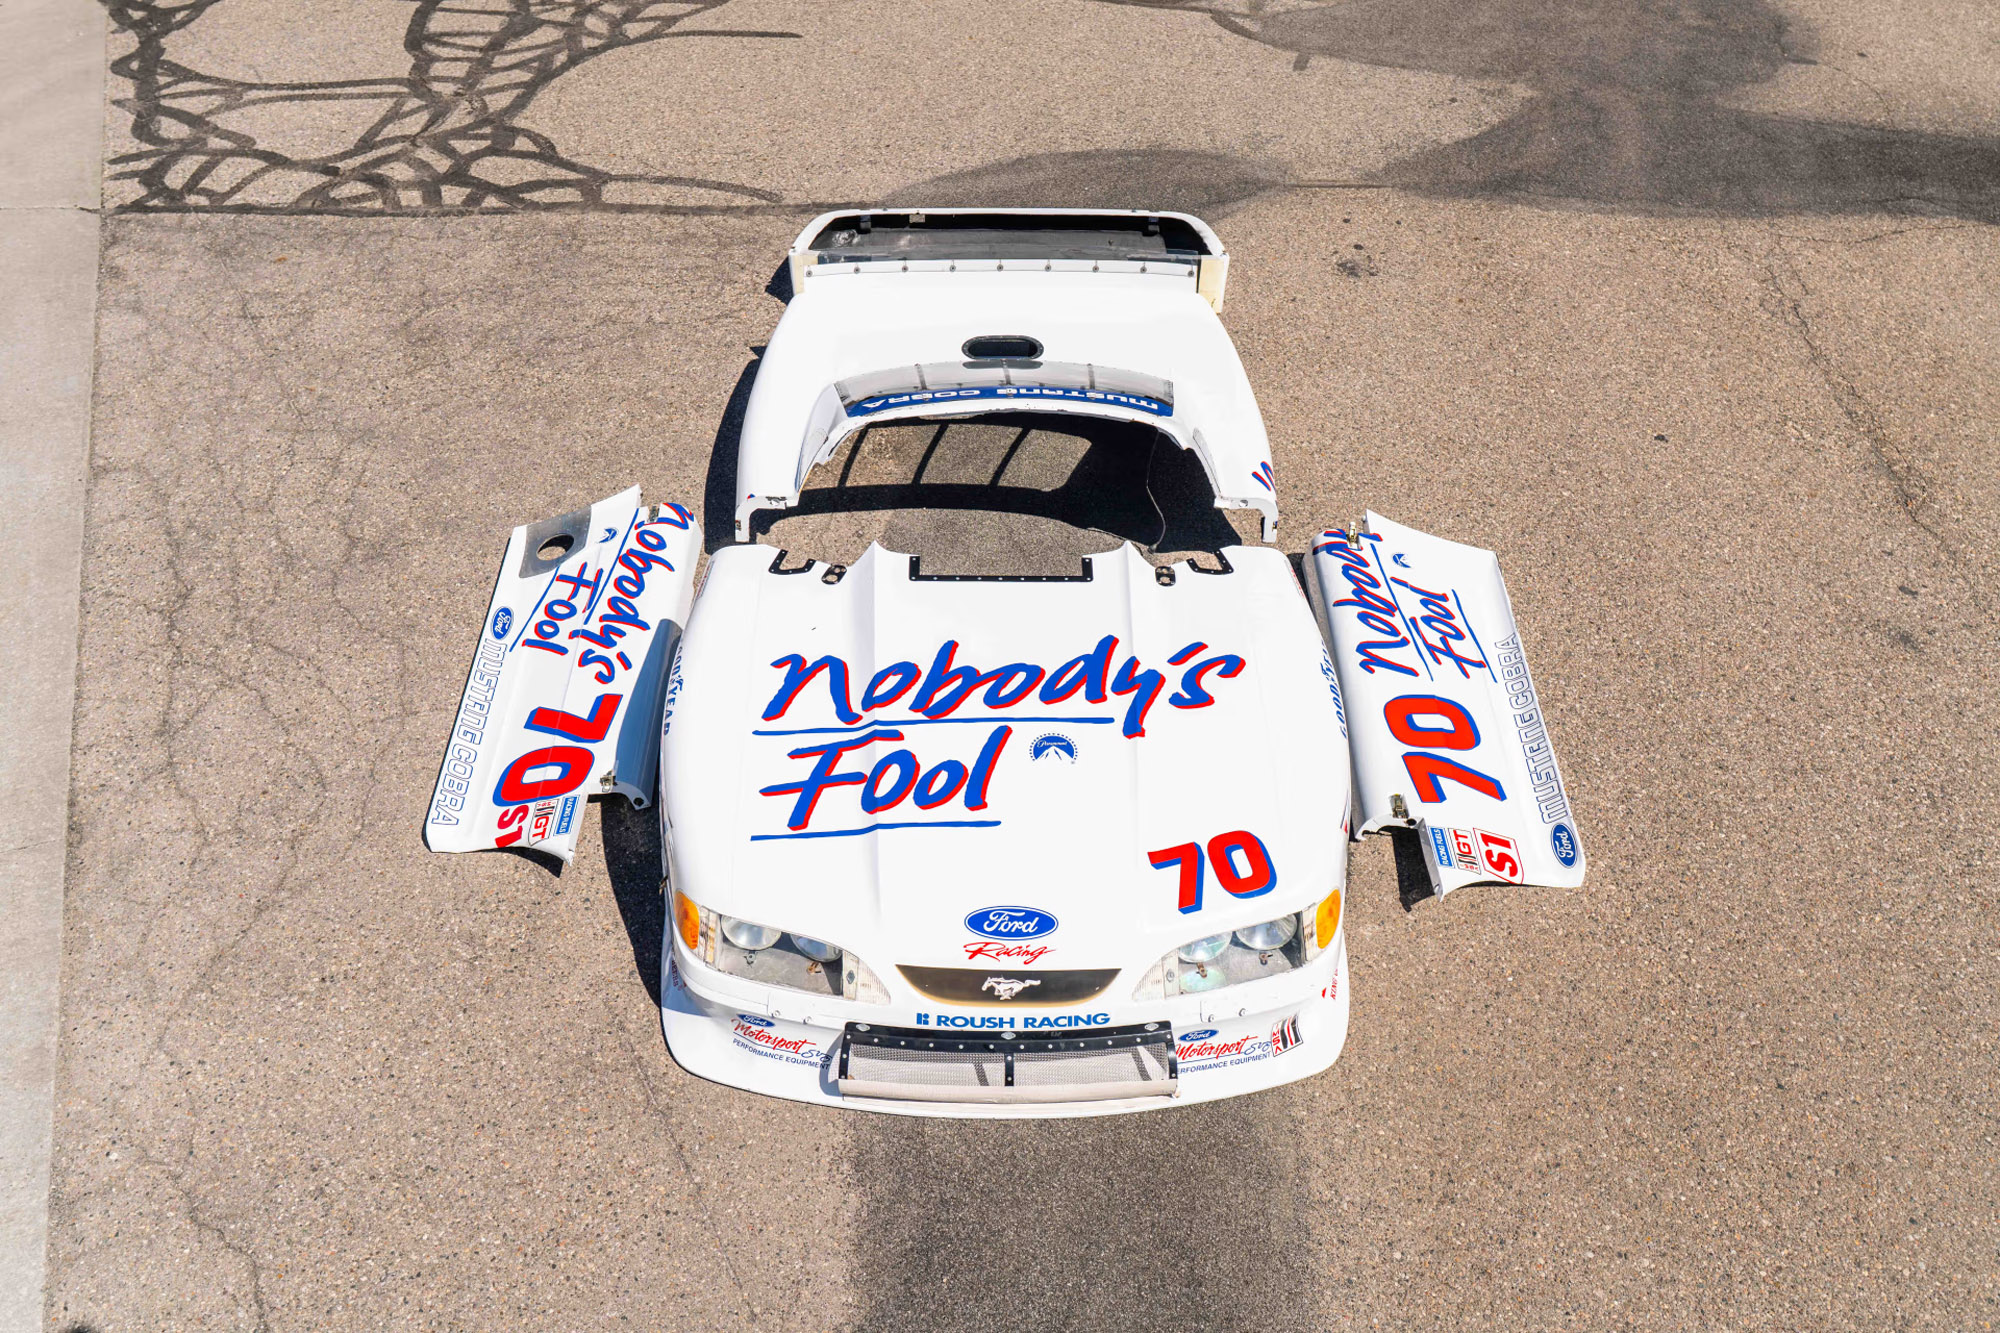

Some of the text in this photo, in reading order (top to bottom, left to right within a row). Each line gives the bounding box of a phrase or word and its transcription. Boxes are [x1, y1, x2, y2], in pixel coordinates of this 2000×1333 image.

[862, 386, 1159, 410] MUSTANG COBRA
[522, 562, 603, 656] Fool
[1390, 576, 1487, 679] Fool
[431, 637, 508, 826] MUSTANG COBRA
[1494, 632, 1569, 825] MUSTANG COBRA
[492, 693, 623, 807] 70
[1383, 694, 1508, 803] 70
[759, 725, 1013, 832] Fool
[532, 815, 549, 840] GT
[1453, 829, 1472, 854] GT
[1147, 830, 1277, 915] 70
[1479, 832, 1518, 878] S1
[983, 908, 1039, 934] Ford
[963, 942, 1057, 965] Racing
[731, 1017, 817, 1054] Motorsport
[936, 1013, 1111, 1029] ROUSH RACING
[732, 1038, 831, 1070] PERFORMANCE EQUIPMENT
[1176, 1035, 1258, 1060] Motorsport
[1229, 1051, 1272, 1067] EQUIPMENT
